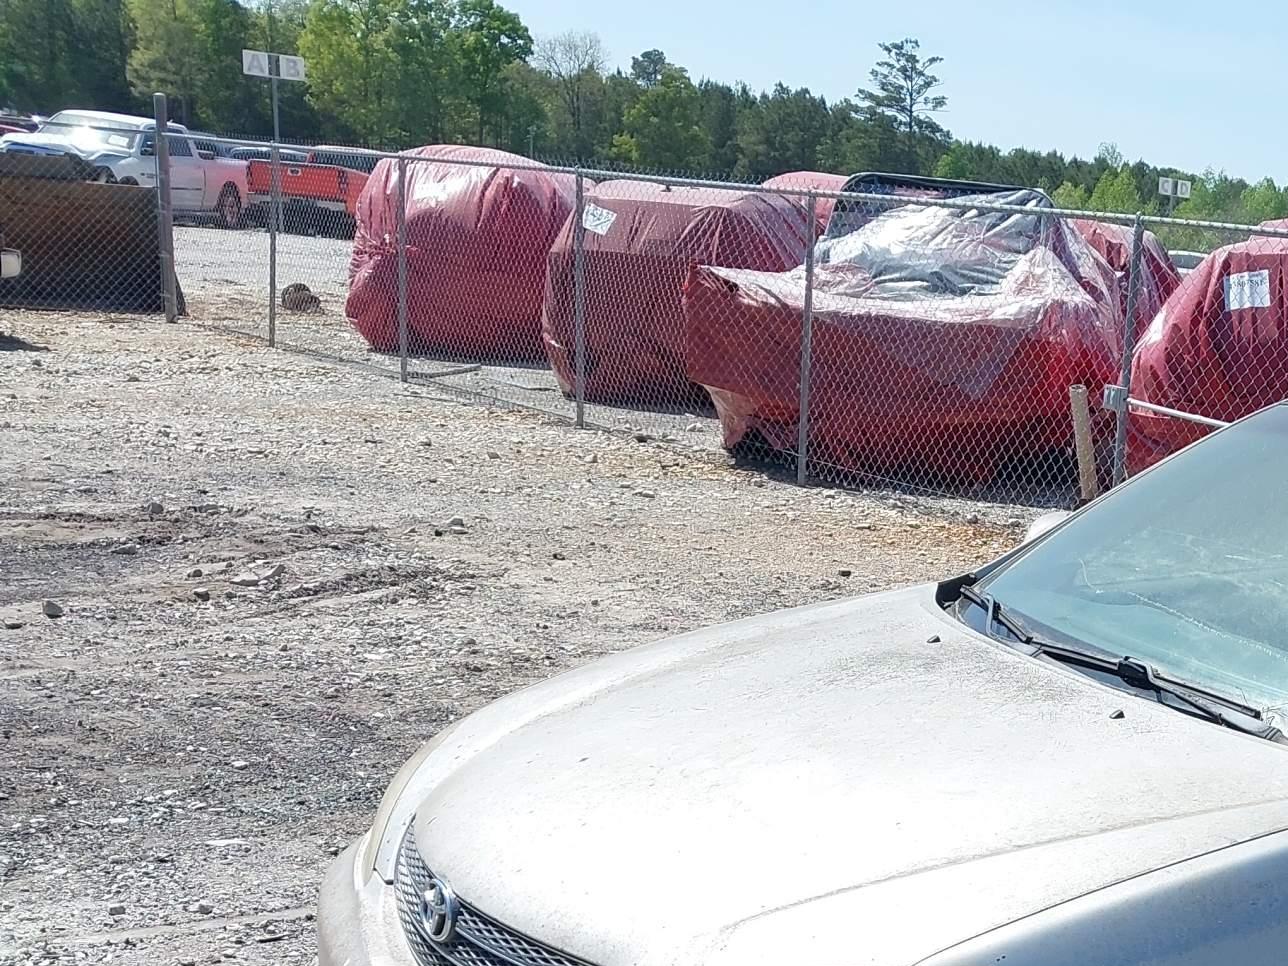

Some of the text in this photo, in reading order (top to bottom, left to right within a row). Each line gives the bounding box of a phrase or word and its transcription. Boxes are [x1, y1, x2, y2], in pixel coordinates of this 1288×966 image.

[246, 53, 301, 78] A B
[1161, 179, 1189, 196] C D
